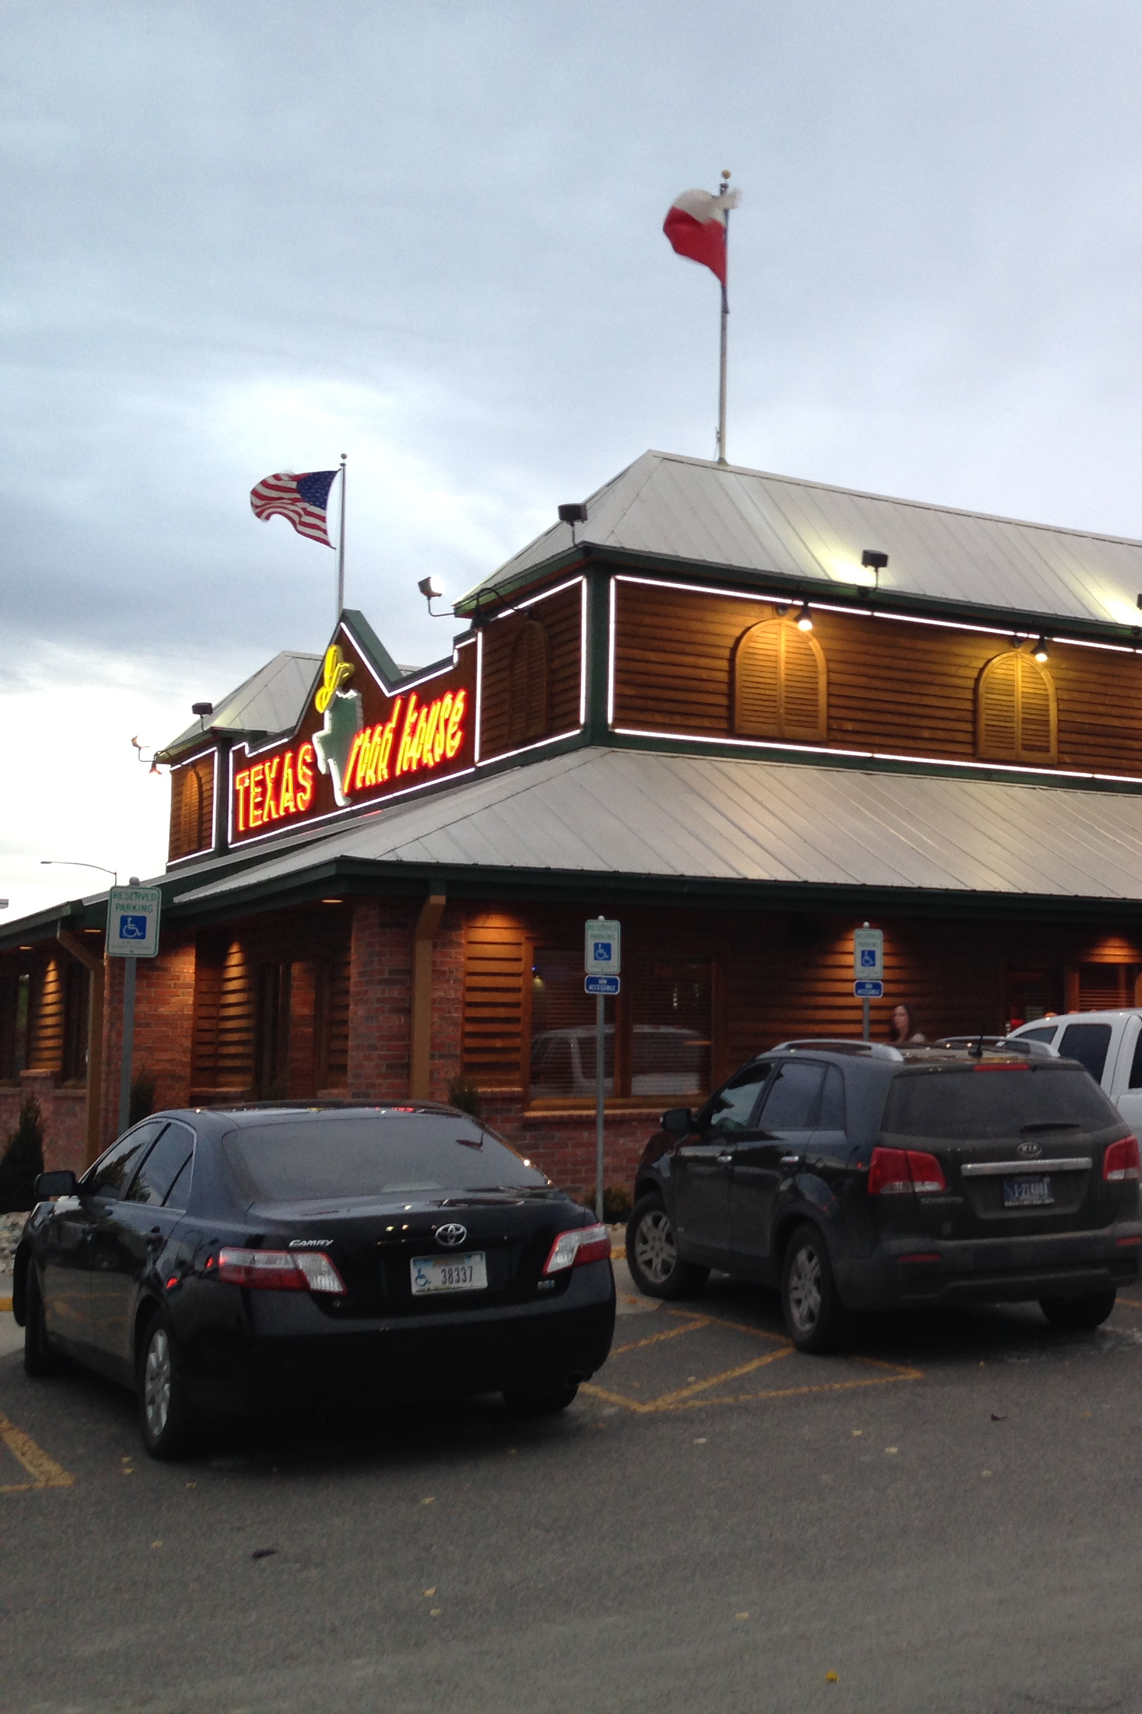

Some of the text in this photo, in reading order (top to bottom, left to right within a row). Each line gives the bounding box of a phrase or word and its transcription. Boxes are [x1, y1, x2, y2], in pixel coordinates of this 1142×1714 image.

[235, 742, 315, 832] TEXAS
[113, 891, 158, 902] RESERVED
[115, 904, 154, 913] PARKING
[1020, 1144, 1038, 1153] KIA
[288, 1239, 334, 1248] CAMRY
[440, 1265, 474, 1285] 38337
